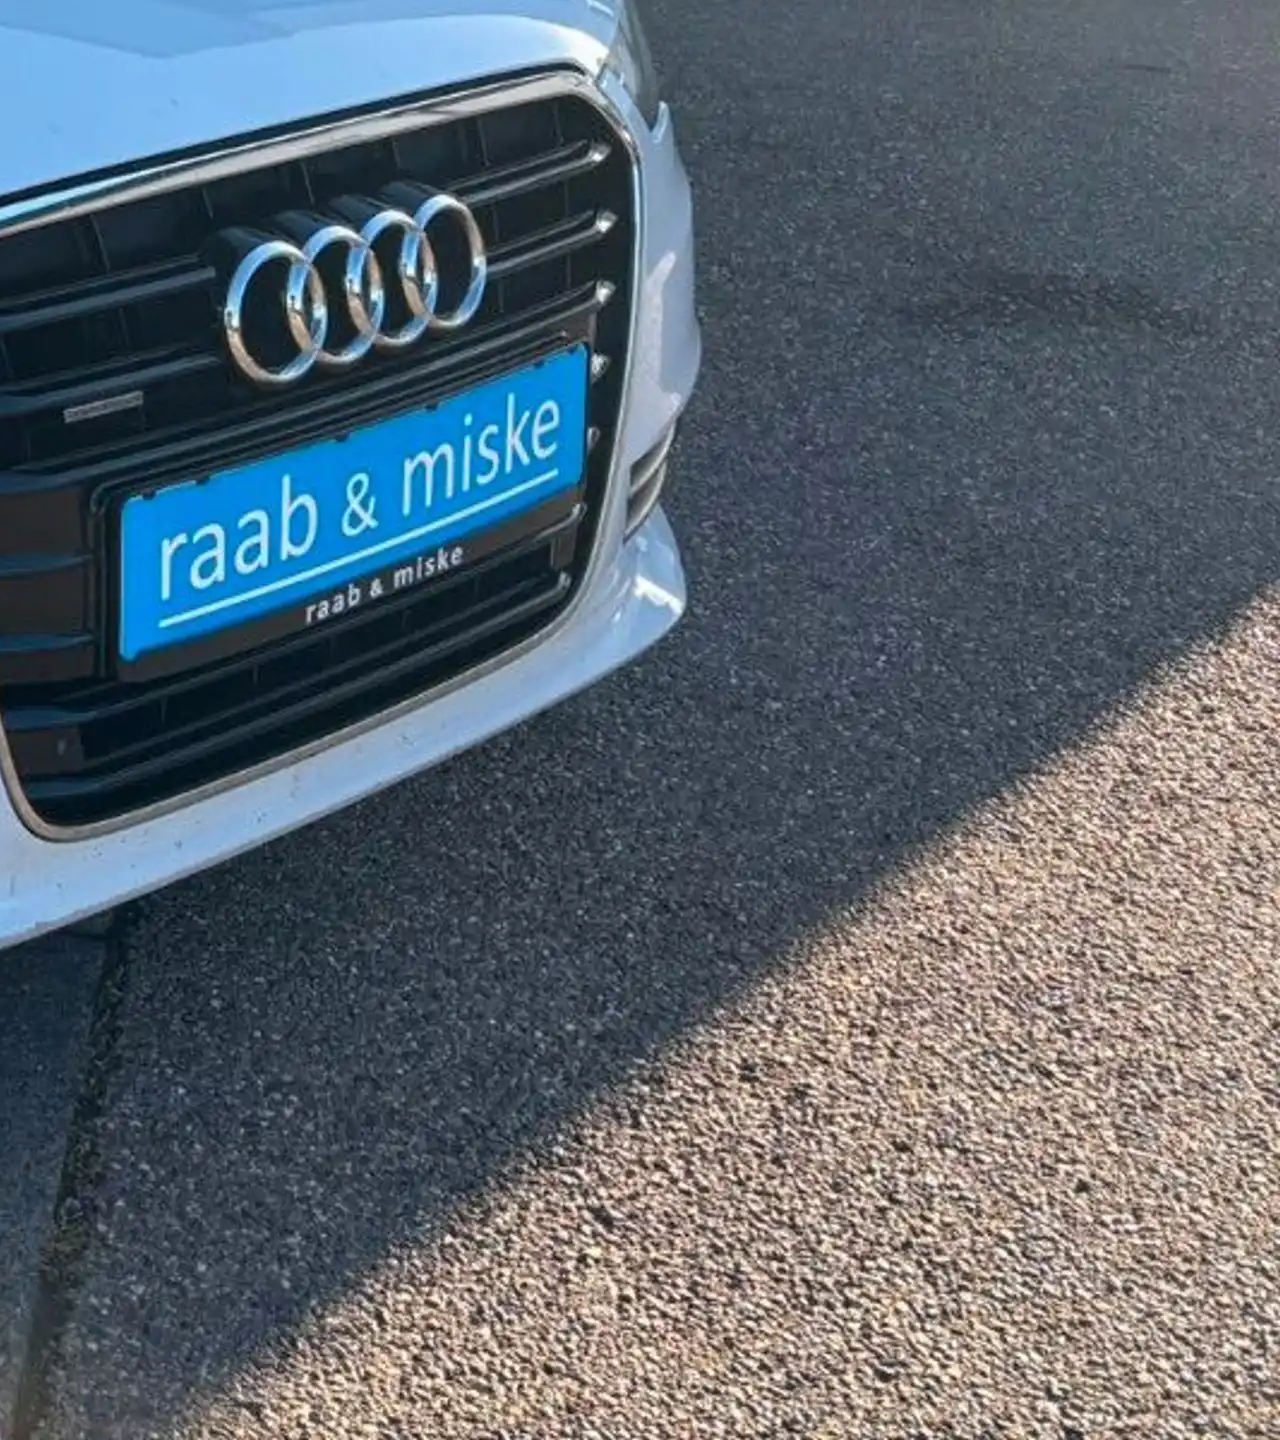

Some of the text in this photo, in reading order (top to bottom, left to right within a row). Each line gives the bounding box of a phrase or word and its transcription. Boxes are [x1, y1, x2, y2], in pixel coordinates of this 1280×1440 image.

[160, 392, 559, 601] raab & miske
[305, 545, 464, 625] raab & miske
